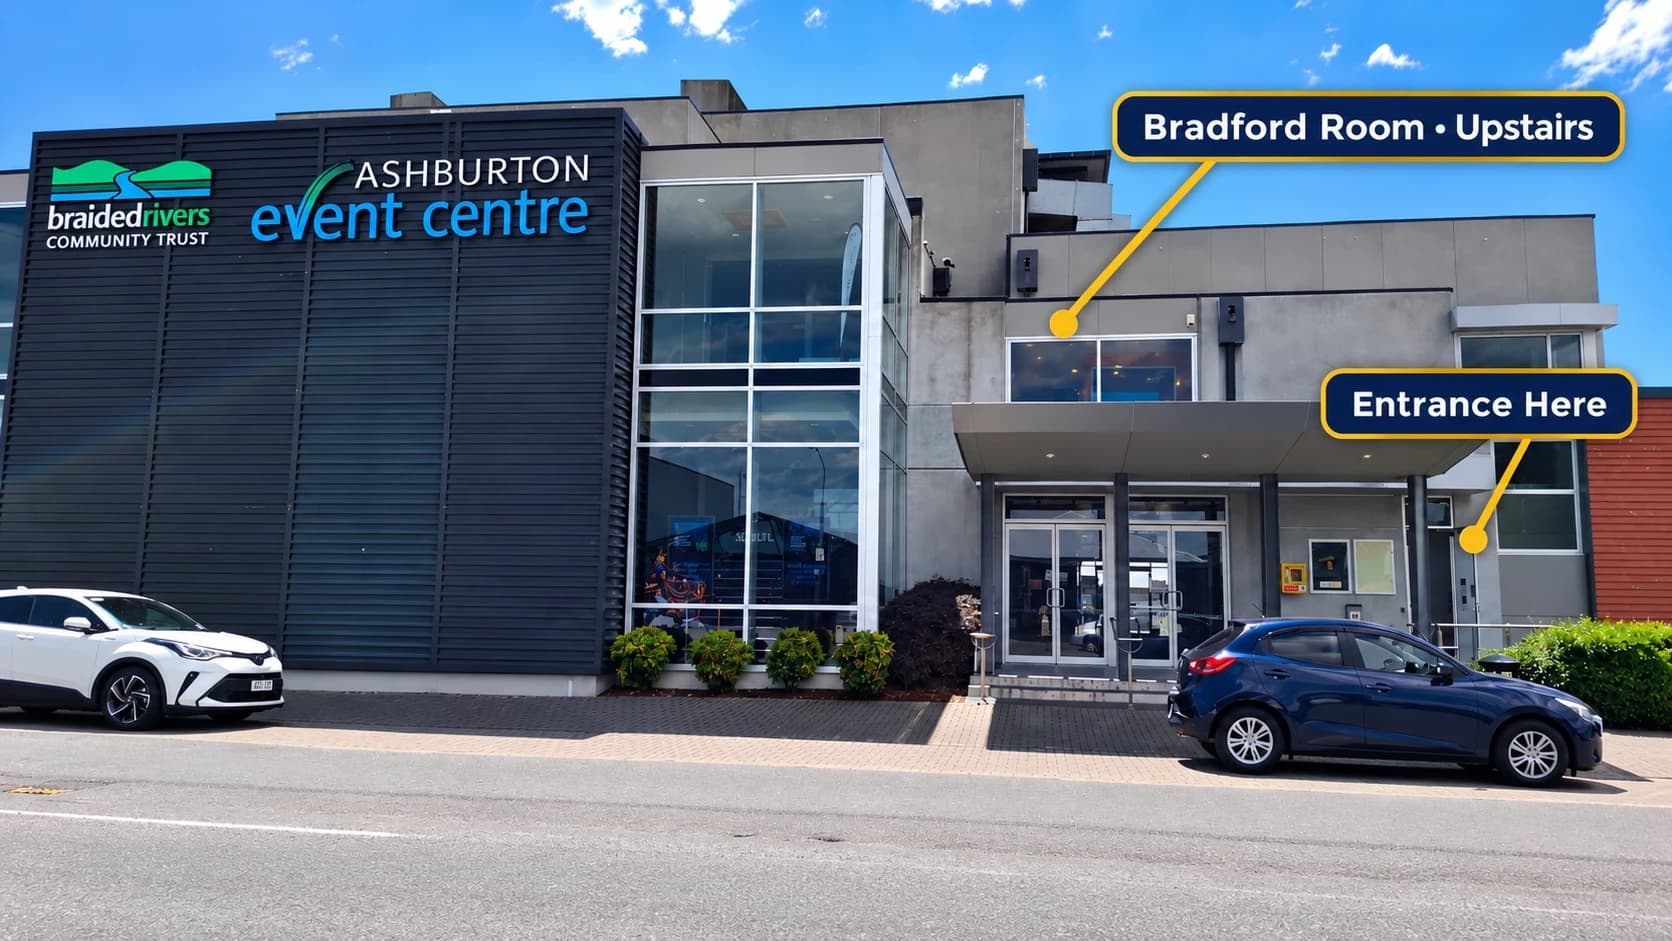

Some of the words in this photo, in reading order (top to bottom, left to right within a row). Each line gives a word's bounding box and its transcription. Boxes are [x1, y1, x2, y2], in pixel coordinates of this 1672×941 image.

[354, 154, 589, 189] ASHBURTON
[47, 202, 210, 230] braidedrivers
[250, 161, 404, 242] event
[422, 189, 589, 238] centre
[46, 233, 152, 249] COMMUNITY
[156, 231, 209, 246] TRUST
